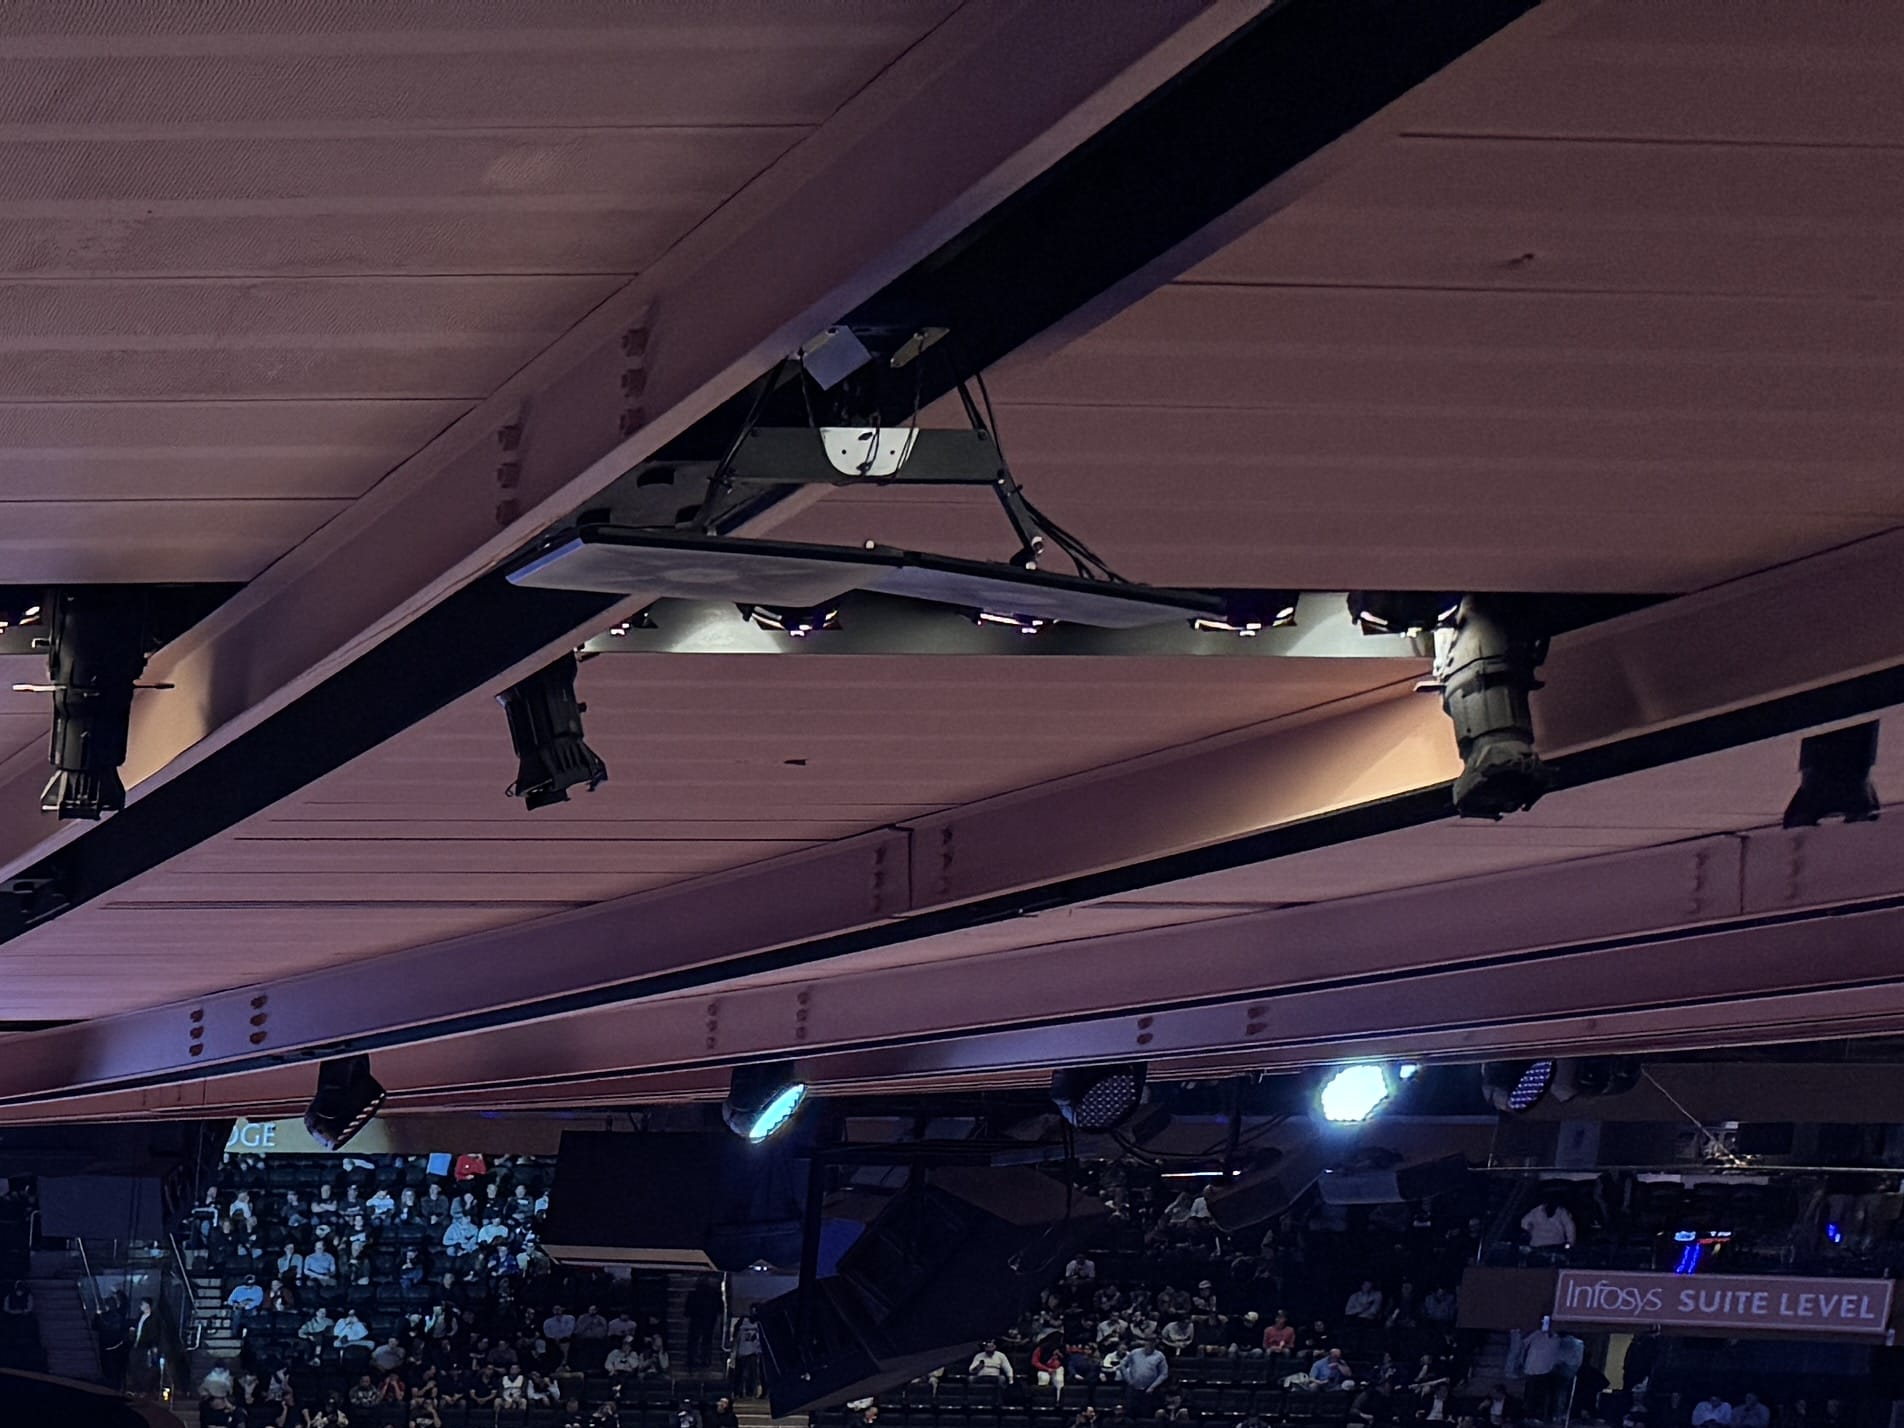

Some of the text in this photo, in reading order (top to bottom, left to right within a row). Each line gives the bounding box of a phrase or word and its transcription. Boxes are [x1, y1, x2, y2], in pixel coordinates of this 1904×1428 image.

[1566, 1280, 1876, 1321] Infosys SUITE LEVEL
